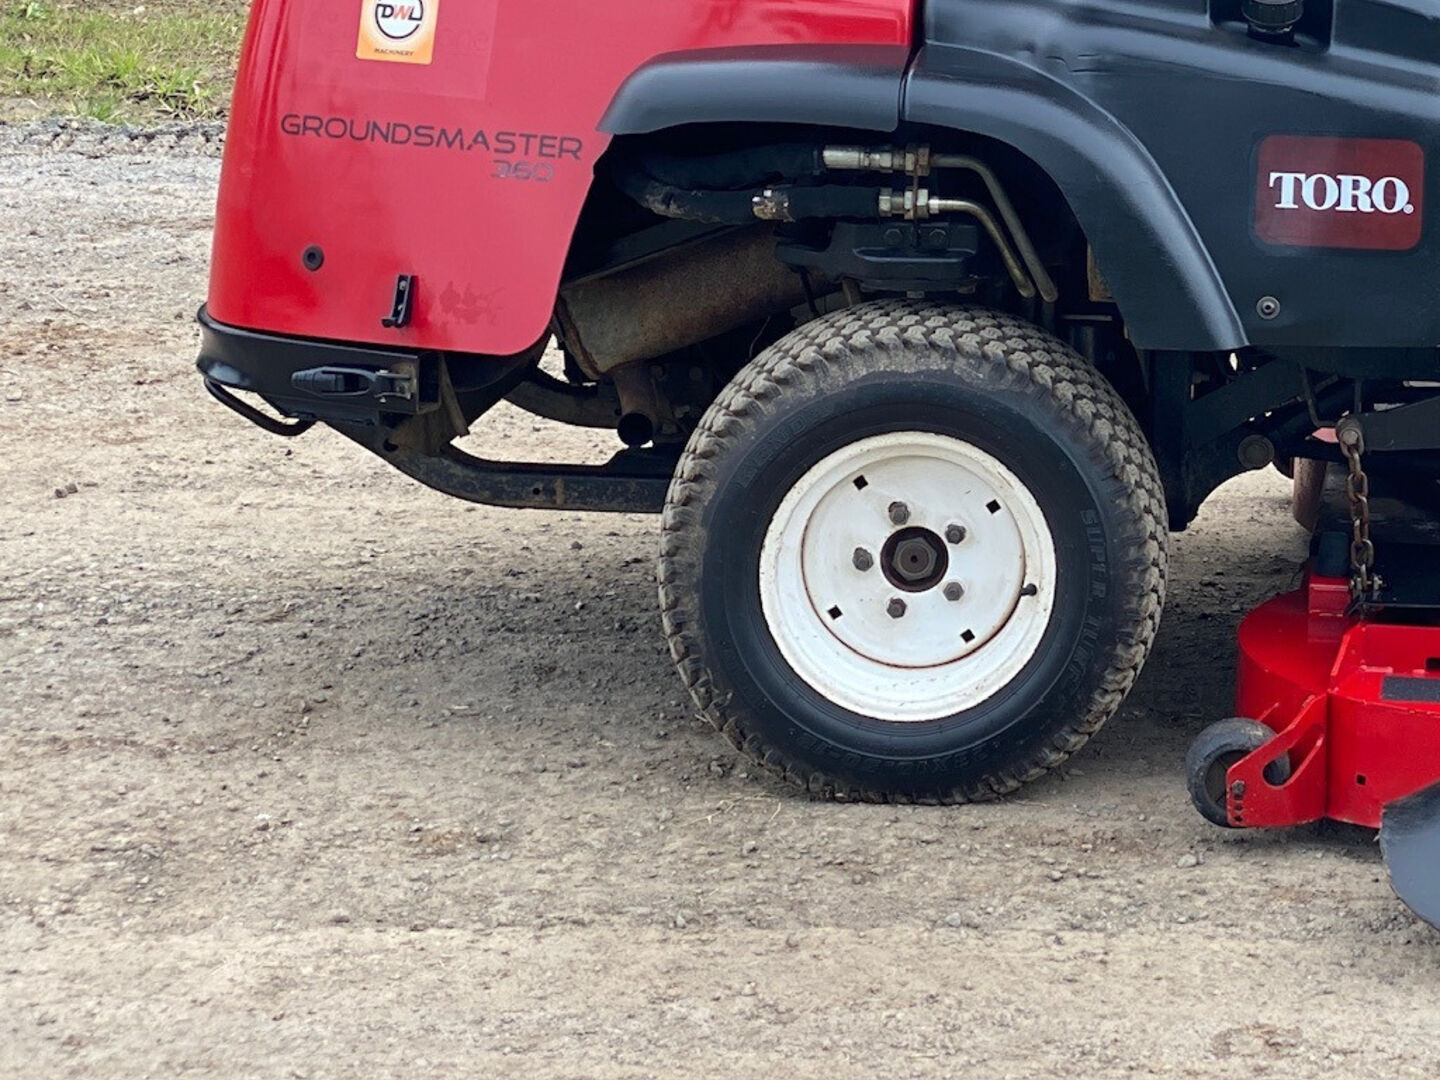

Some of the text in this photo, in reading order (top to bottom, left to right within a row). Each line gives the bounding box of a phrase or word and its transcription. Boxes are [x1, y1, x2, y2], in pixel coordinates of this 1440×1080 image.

[377, 3, 422, 21] DWL
[281, 114, 583, 160] GROUNDSMASTER
[491, 159, 555, 182] 360
